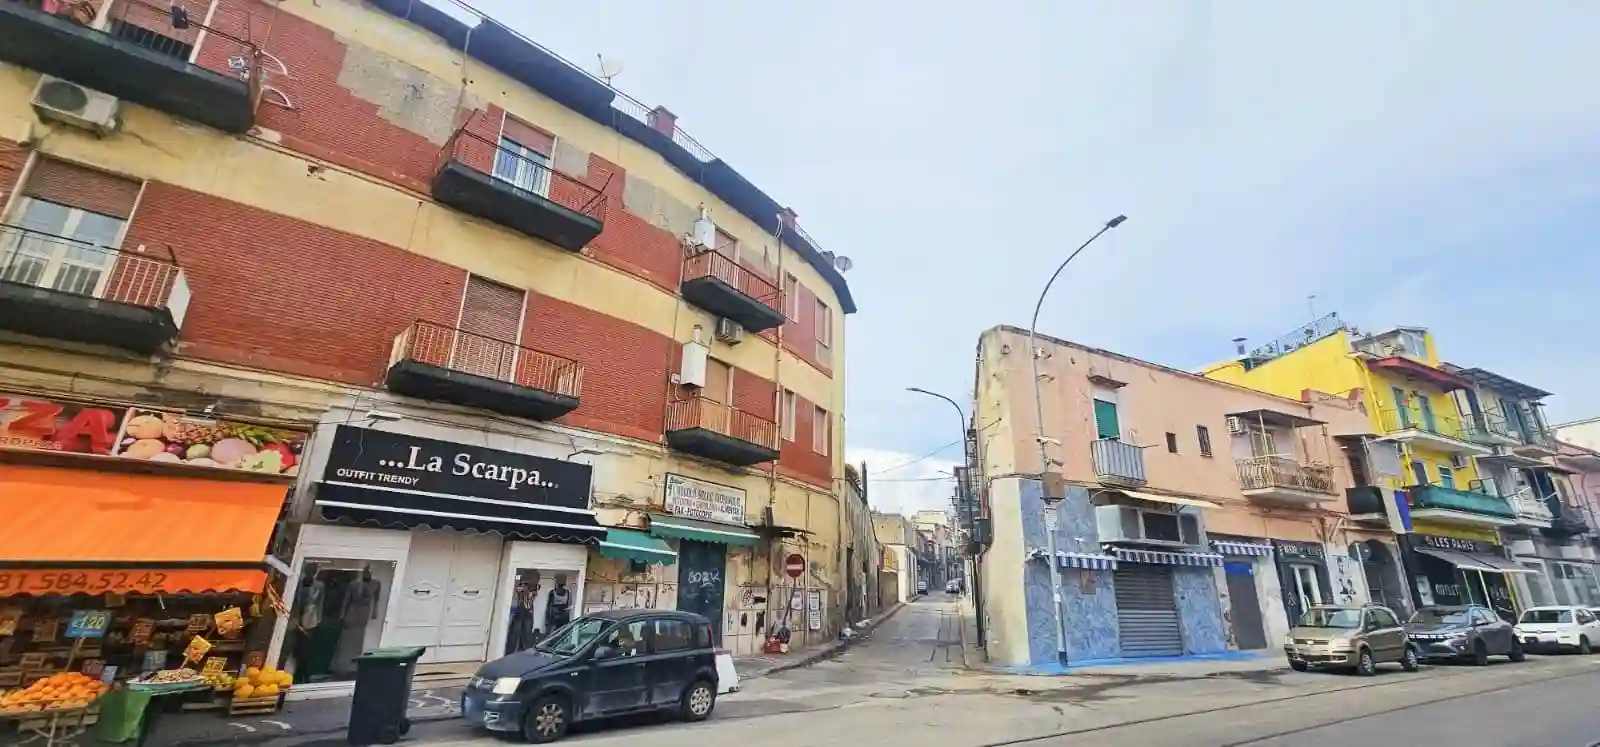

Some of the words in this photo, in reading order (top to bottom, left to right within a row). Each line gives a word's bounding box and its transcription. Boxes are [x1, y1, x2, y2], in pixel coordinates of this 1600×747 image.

[0, 397, 117, 455] ZA
[336, 468, 376, 481] OUTFIT
[377, 473, 420, 487] TRENDY
